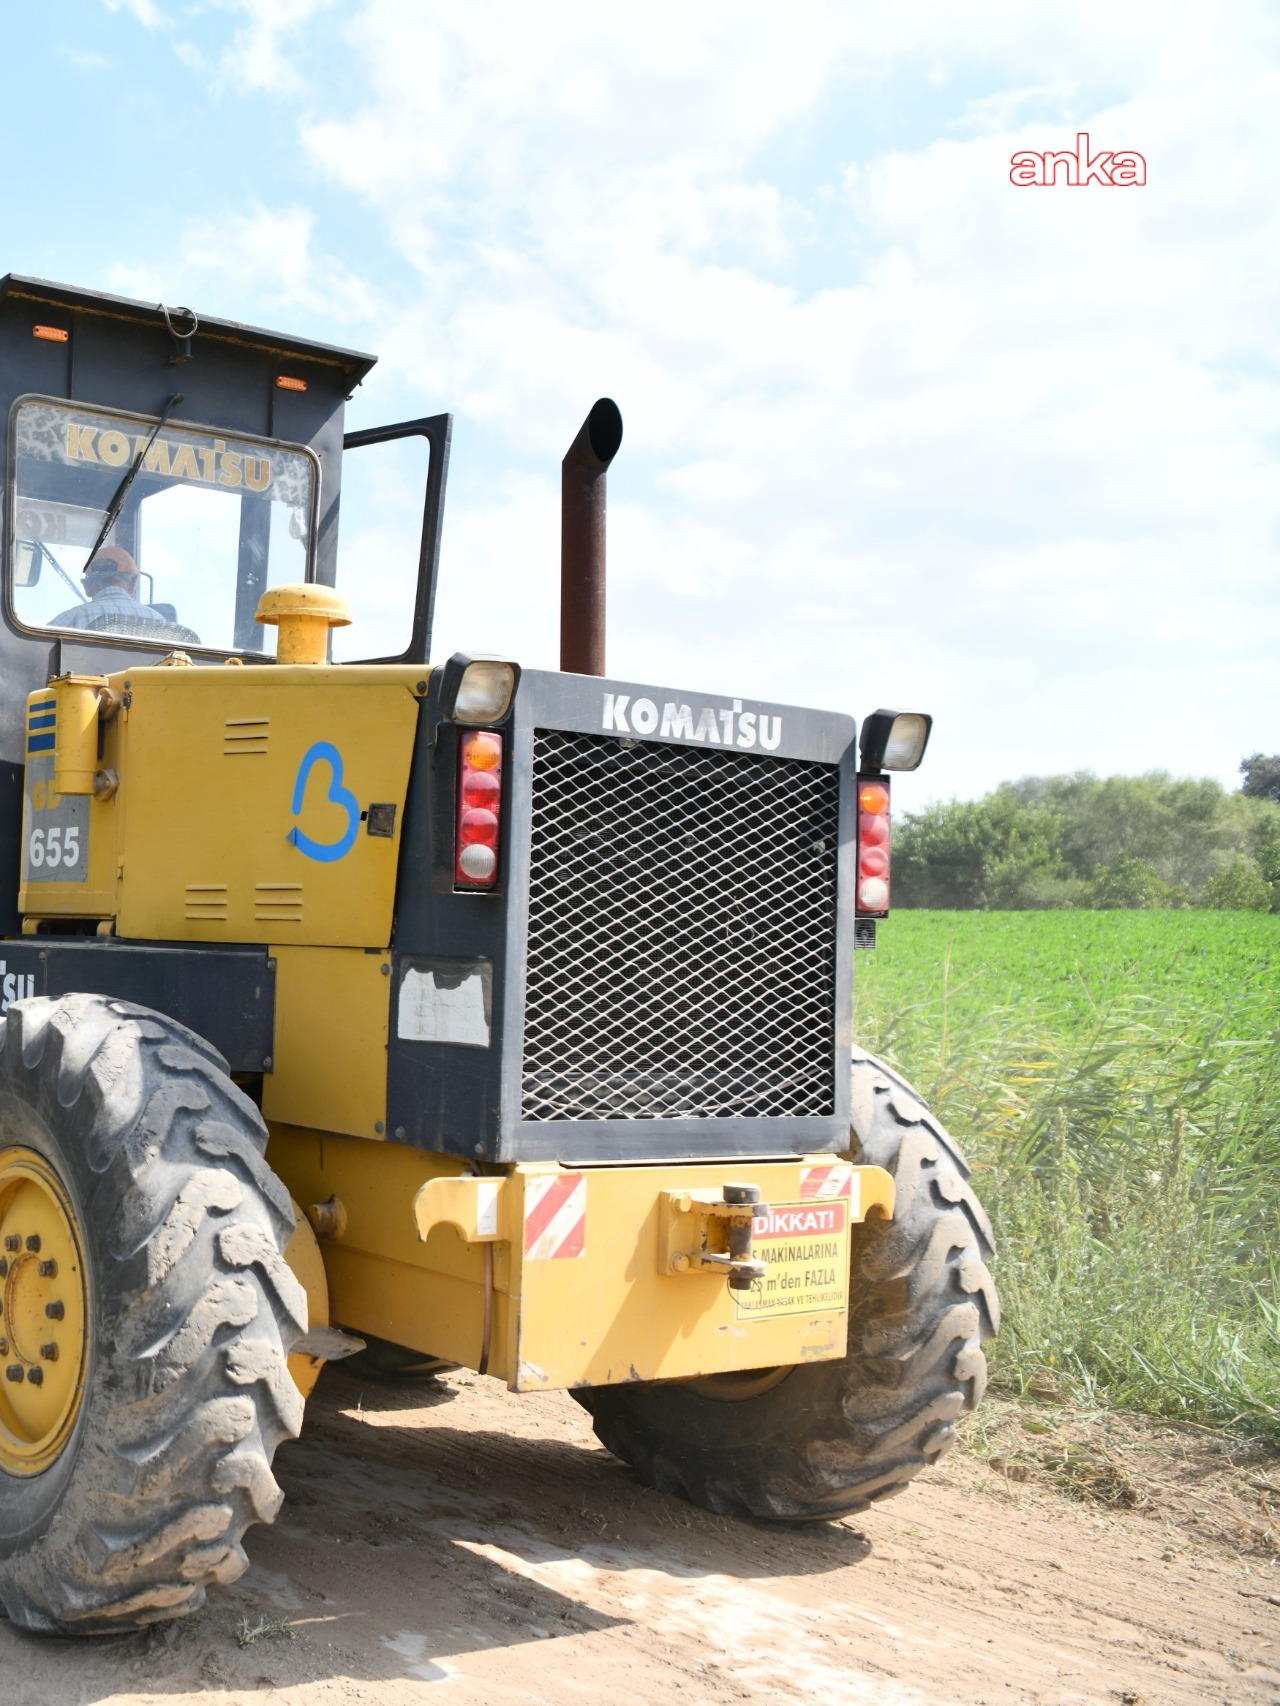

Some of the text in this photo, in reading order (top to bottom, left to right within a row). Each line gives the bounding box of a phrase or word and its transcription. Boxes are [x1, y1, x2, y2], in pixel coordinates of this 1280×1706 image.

[67, 423, 271, 492] KOMATSU
[602, 693, 782, 750] KOMATSU
[29, 826, 80, 867] 655
[754, 1210, 834, 1235] DİKKAT!
[761, 1242, 839, 1264] MAKİNALARINA
[805, 1268, 836, 1287] FAZLA
